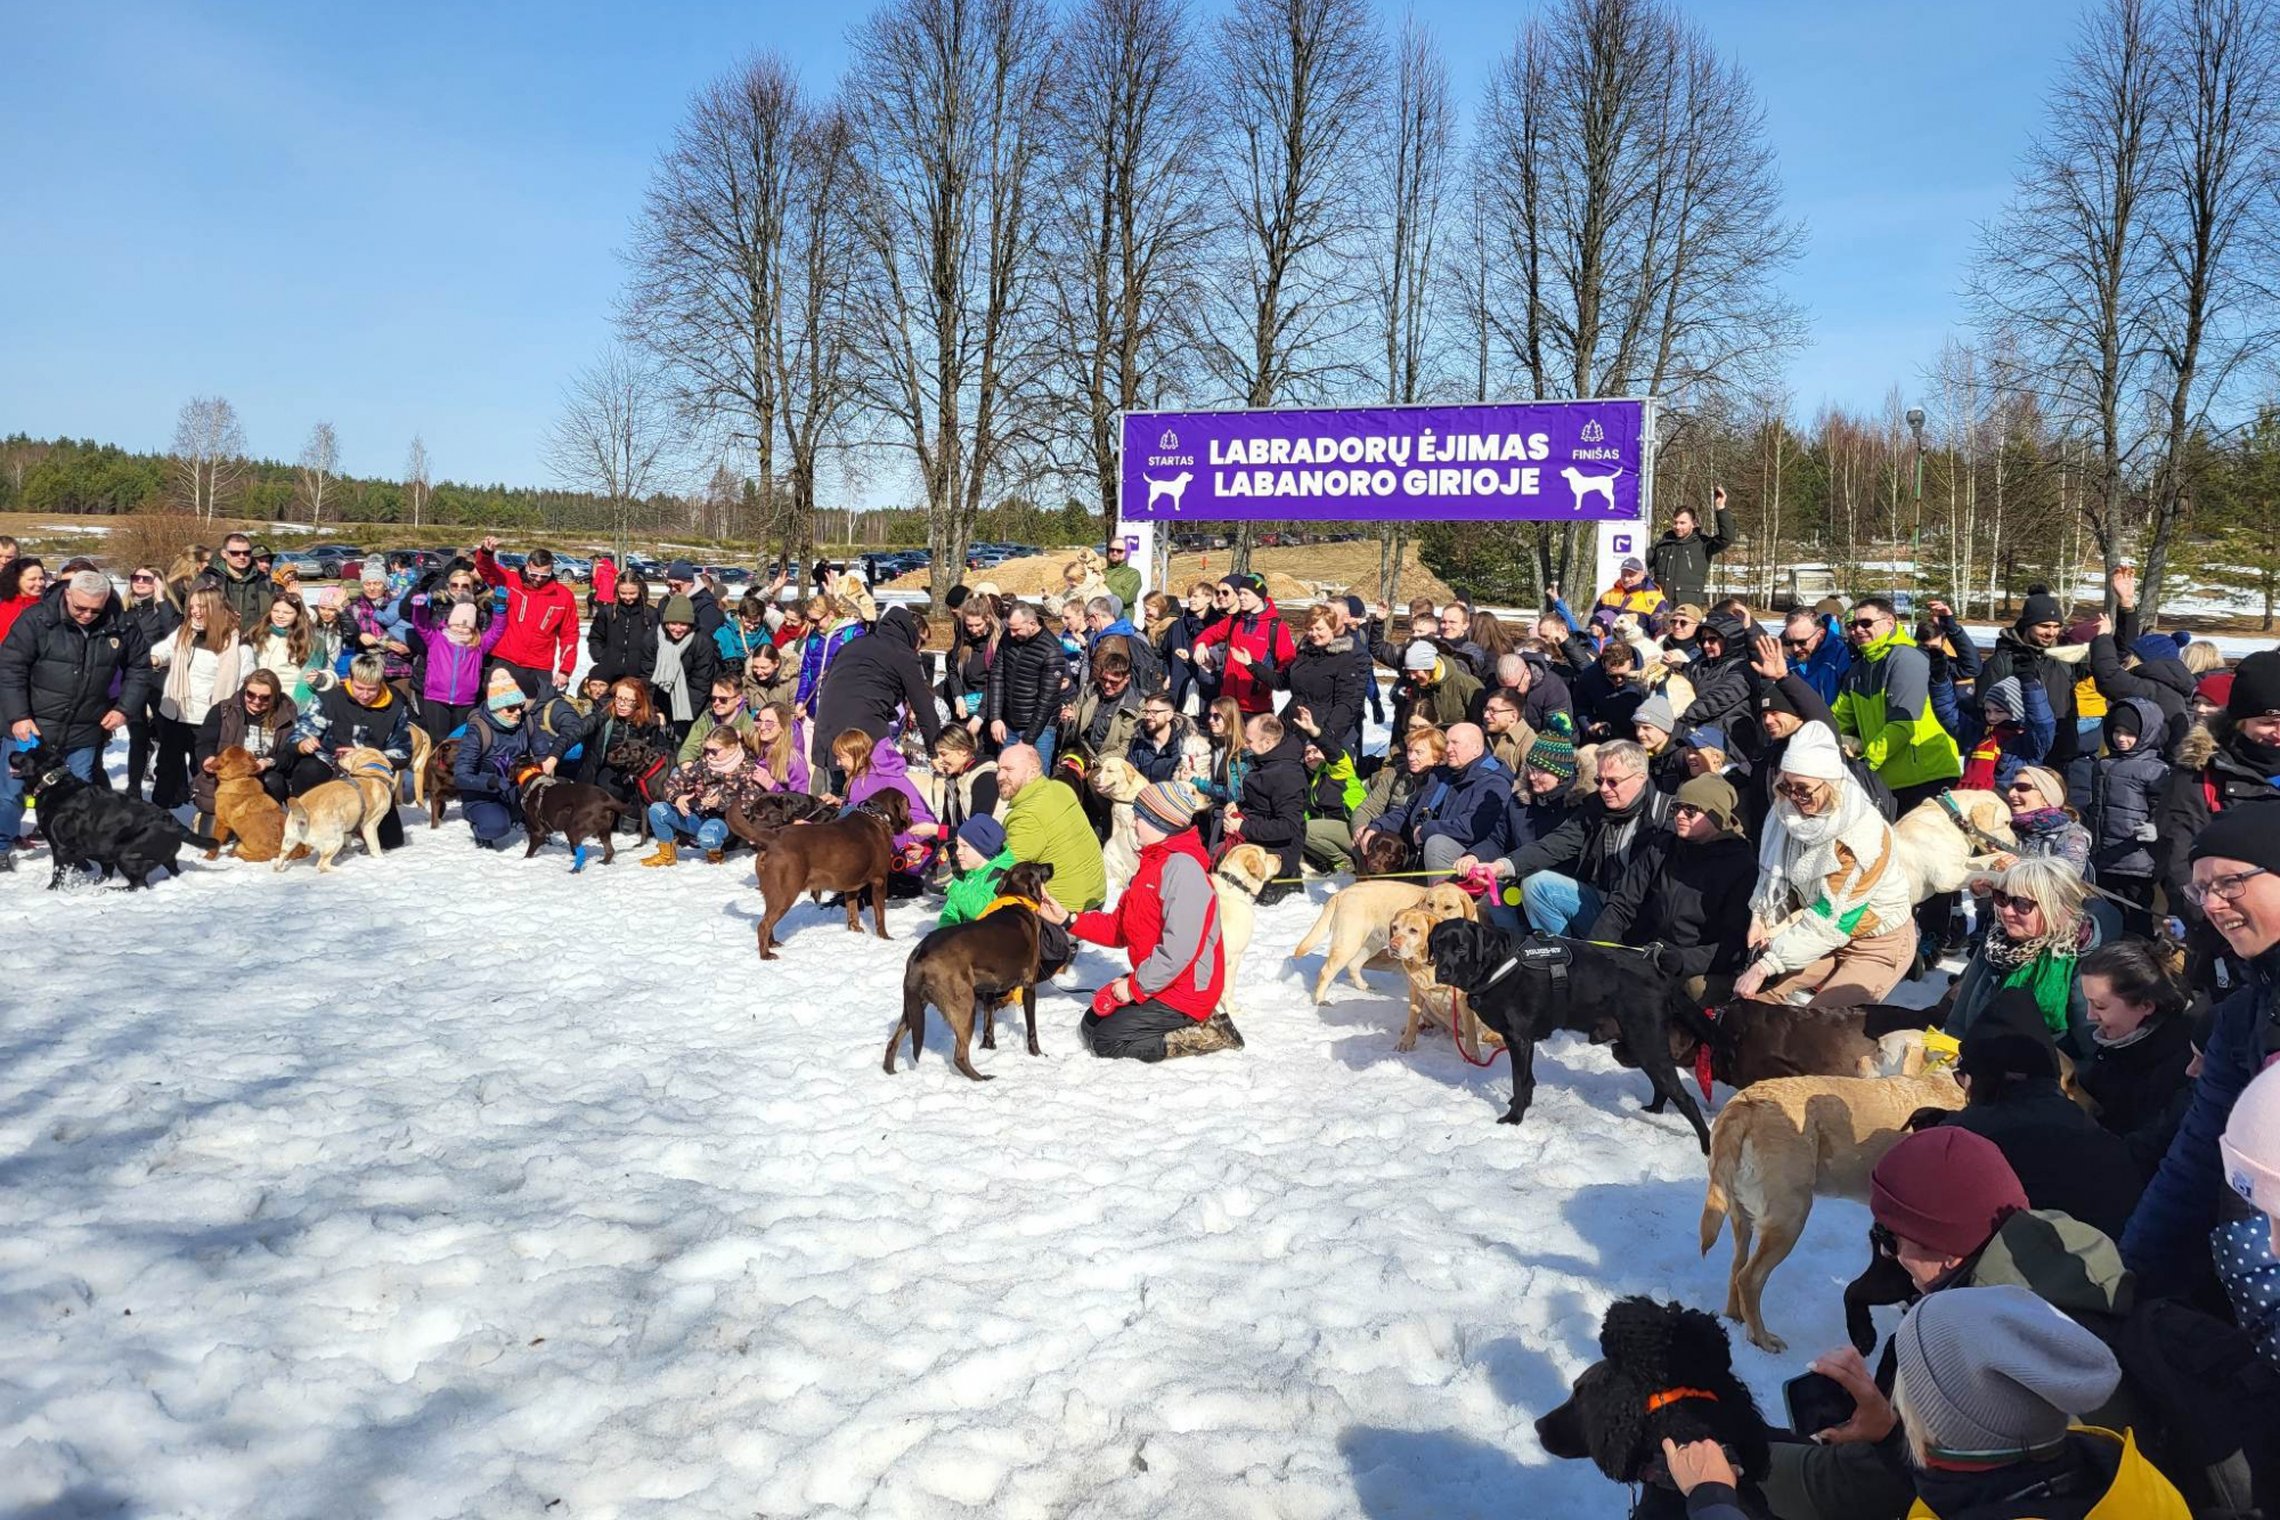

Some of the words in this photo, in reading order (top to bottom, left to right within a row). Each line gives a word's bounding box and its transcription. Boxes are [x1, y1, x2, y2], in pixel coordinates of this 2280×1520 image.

[1209, 436, 1412, 467] LABRADORŲ
[1417, 428, 1550, 463] ĖJIMAS
[1572, 447, 1620, 460] FINIŠAS
[1148, 455, 1194, 467] STARTAS
[1214, 469, 1397, 497] LABANORO
[1402, 467, 1541, 497] GIRIOJE
